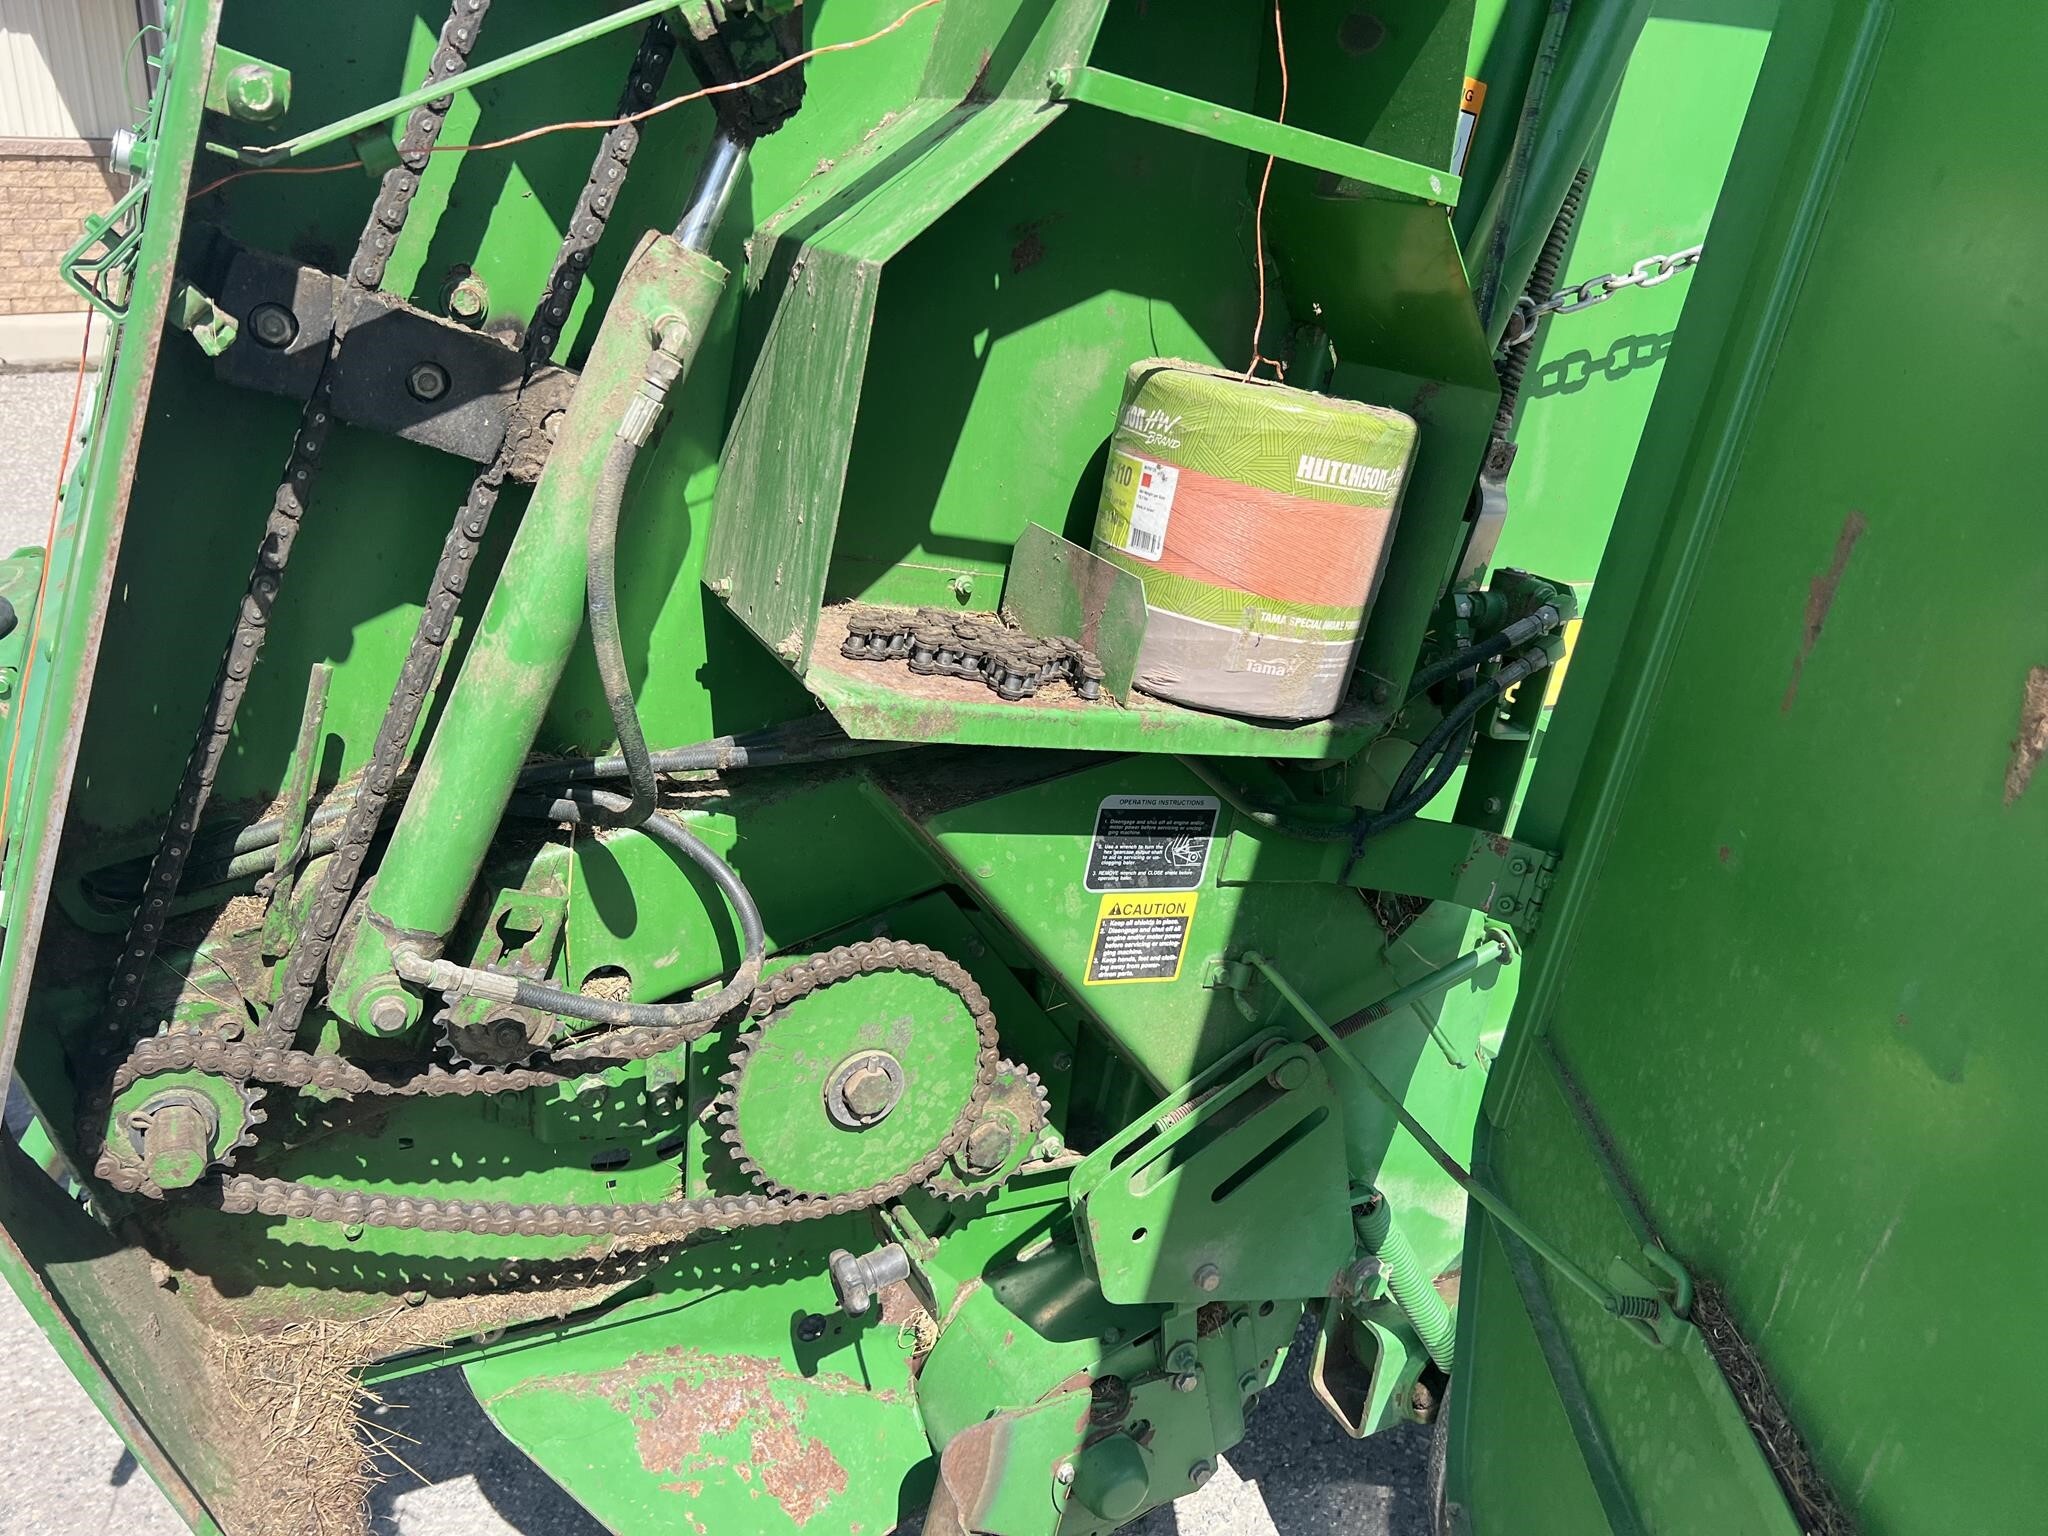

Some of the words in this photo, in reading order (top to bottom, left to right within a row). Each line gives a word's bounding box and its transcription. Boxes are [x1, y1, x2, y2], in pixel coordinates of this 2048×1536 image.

[1145, 430, 1181, 449] BRAND
[1296, 454, 1389, 491] HUTCHISON
[1260, 611, 1287, 625] TAMA
[1289, 616, 1322, 631] SPECIAL
[1246, 659, 1287, 677] Tama
[1123, 903, 1186, 915] CAUTION
